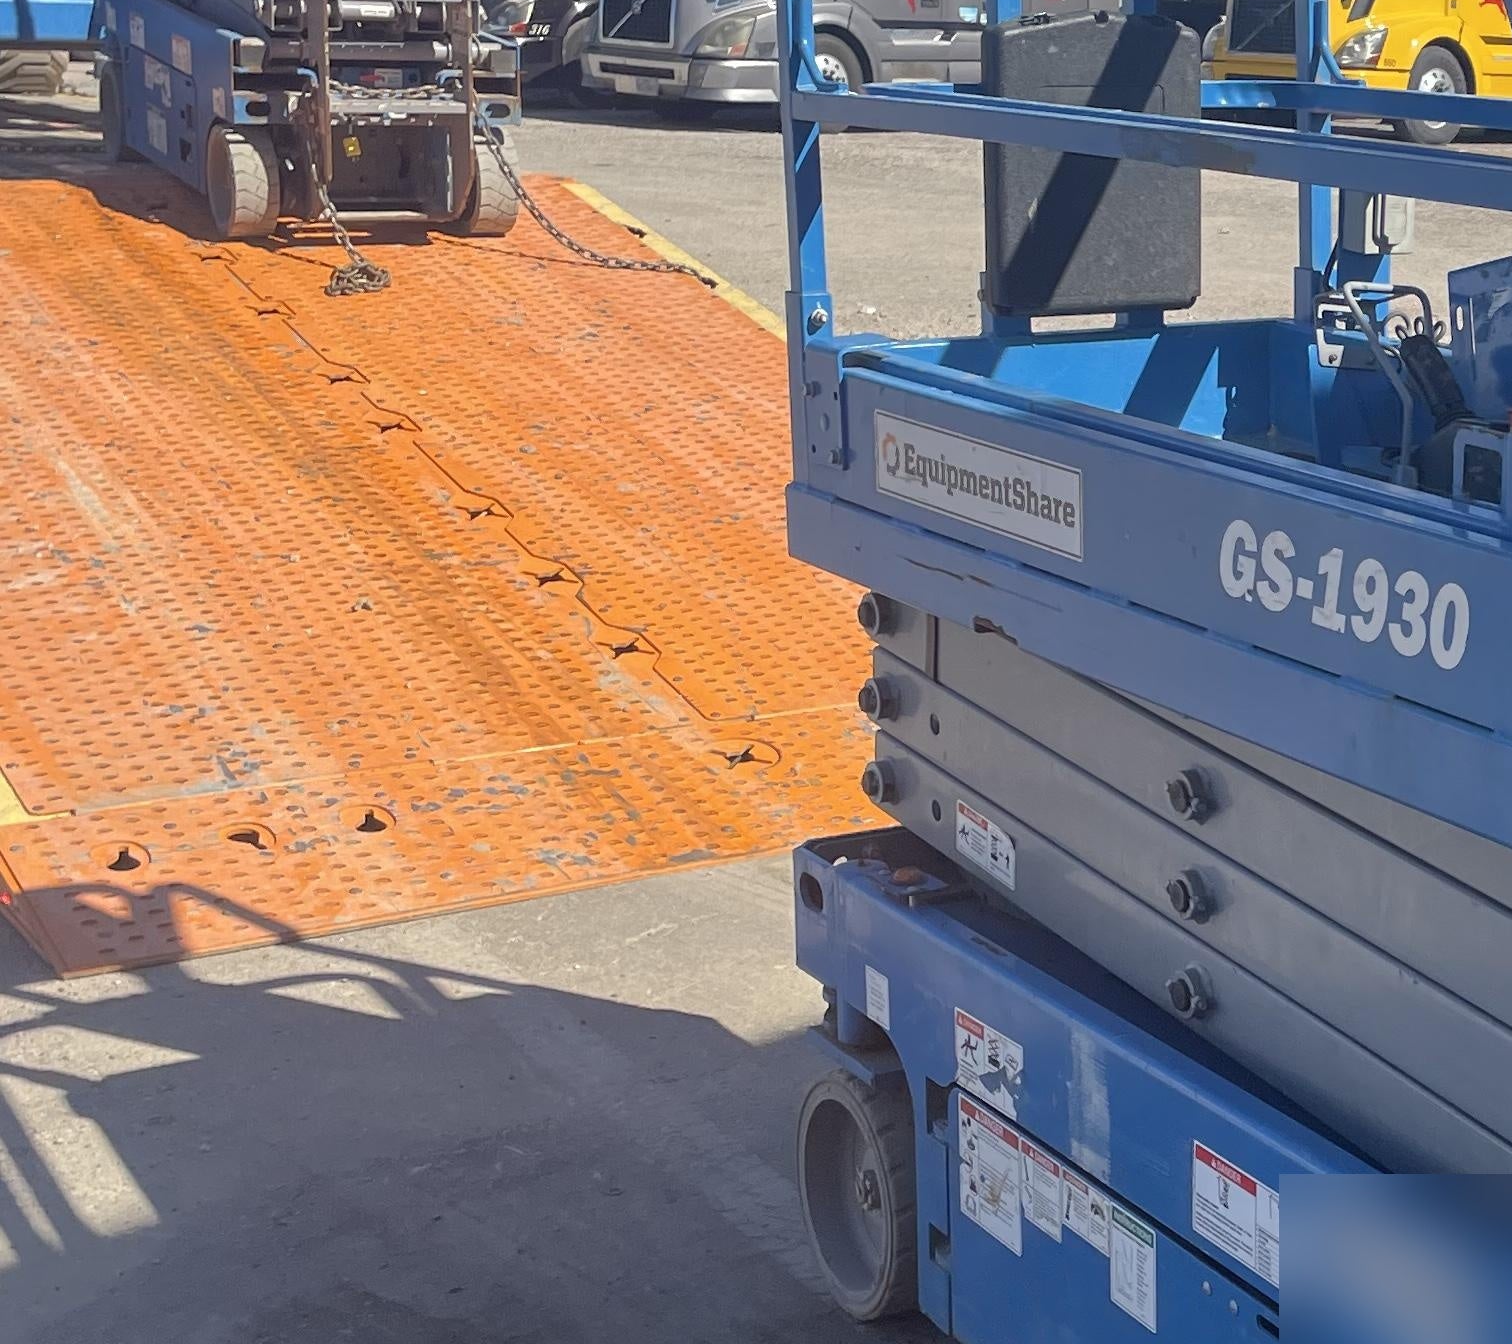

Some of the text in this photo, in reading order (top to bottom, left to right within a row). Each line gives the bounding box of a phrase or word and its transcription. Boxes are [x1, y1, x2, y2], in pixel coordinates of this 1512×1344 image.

[528, 23, 551, 36] 316
[903, 442, 1077, 529] EquipmentShare
[1219, 518, 1471, 671] GS-1930
